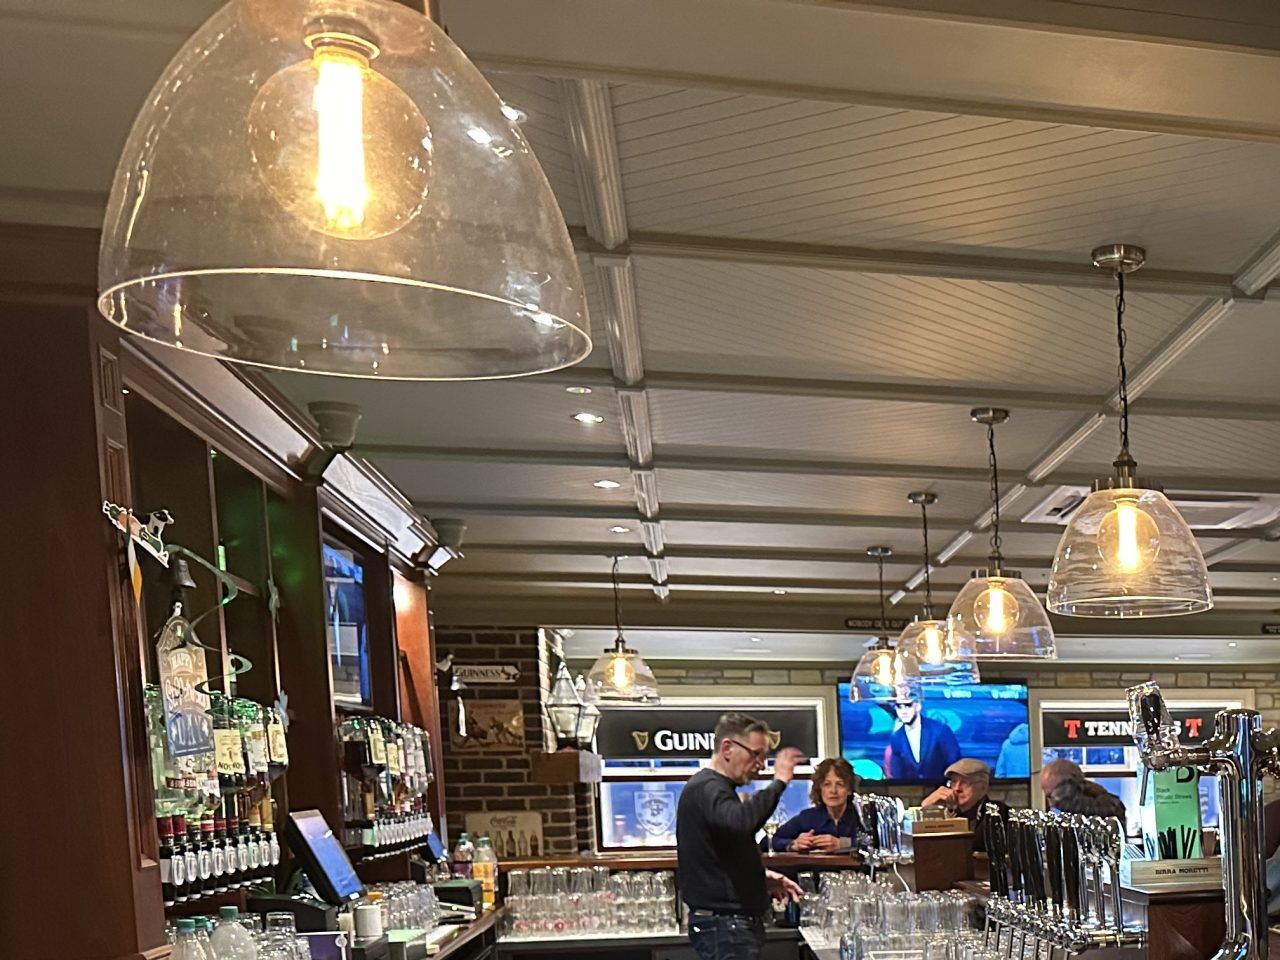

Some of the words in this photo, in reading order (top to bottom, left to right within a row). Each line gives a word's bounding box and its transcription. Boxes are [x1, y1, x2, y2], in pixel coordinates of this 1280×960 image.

[456, 667, 501, 678] GUINNESS
[1064, 720, 1081, 738] T
[1085, 721, 1181, 736] TENNS
[1185, 719, 1202, 737] T
[654, 730, 714, 750] GUIN
